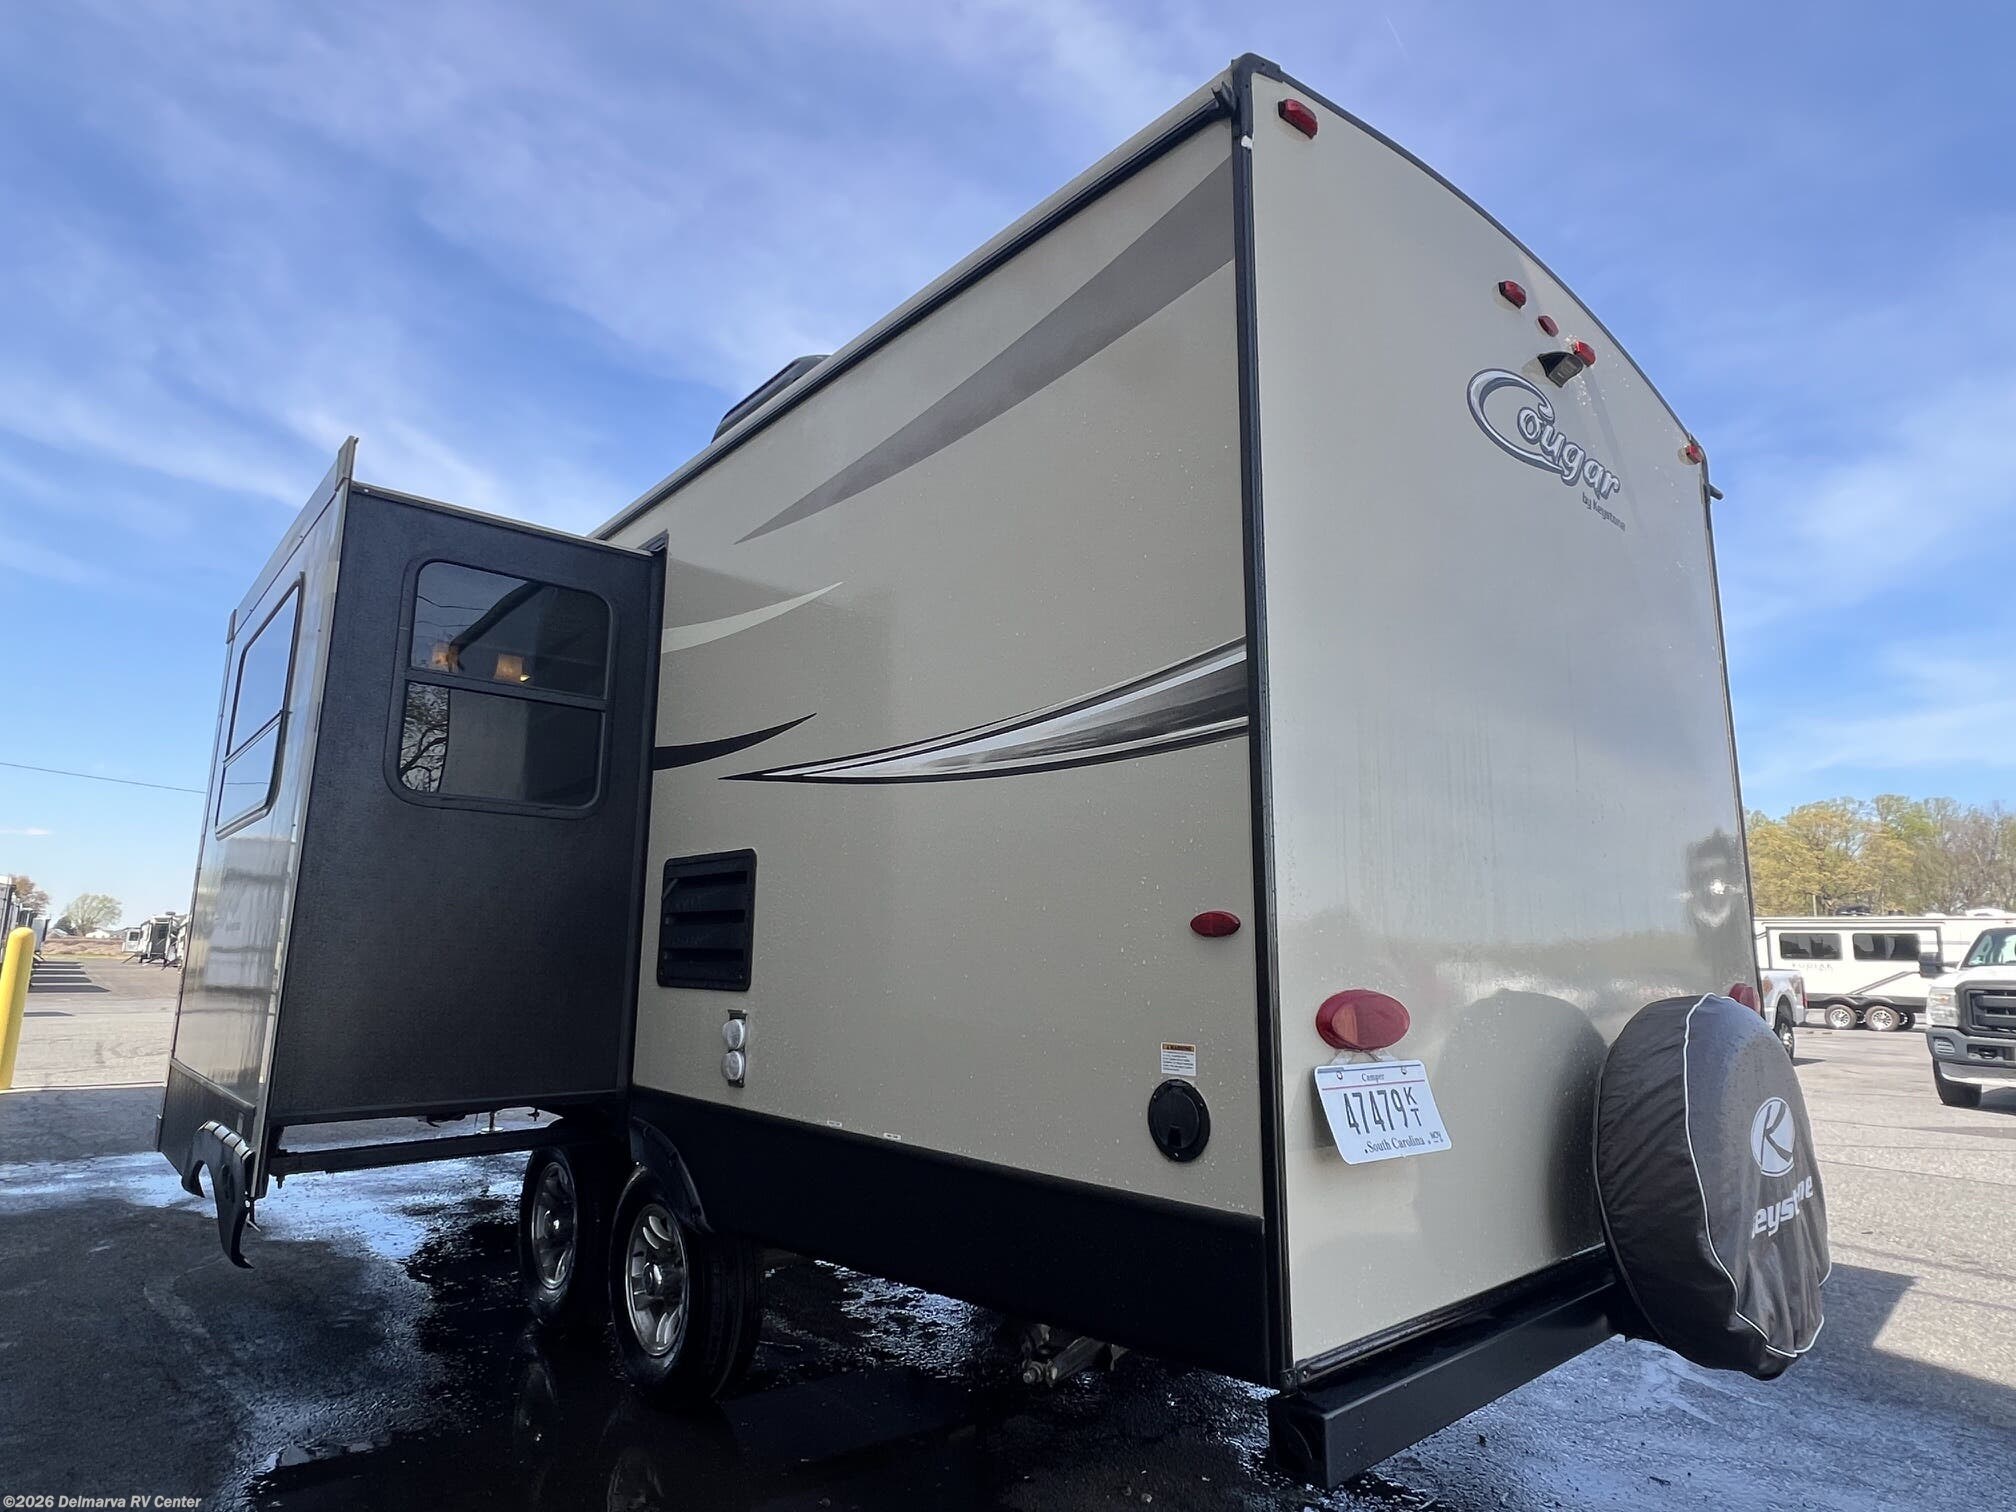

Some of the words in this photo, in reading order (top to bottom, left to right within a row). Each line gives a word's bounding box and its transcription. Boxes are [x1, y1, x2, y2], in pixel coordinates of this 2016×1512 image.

[1467, 368, 1620, 500] Cougar
[1582, 491, 1592, 510] by
[1361, 1072, 1385, 1085] Camper
[1343, 1088, 1409, 1135] 47479
[1366, 1140, 1391, 1153] South
[1391, 1135, 1425, 1149] Carolina
